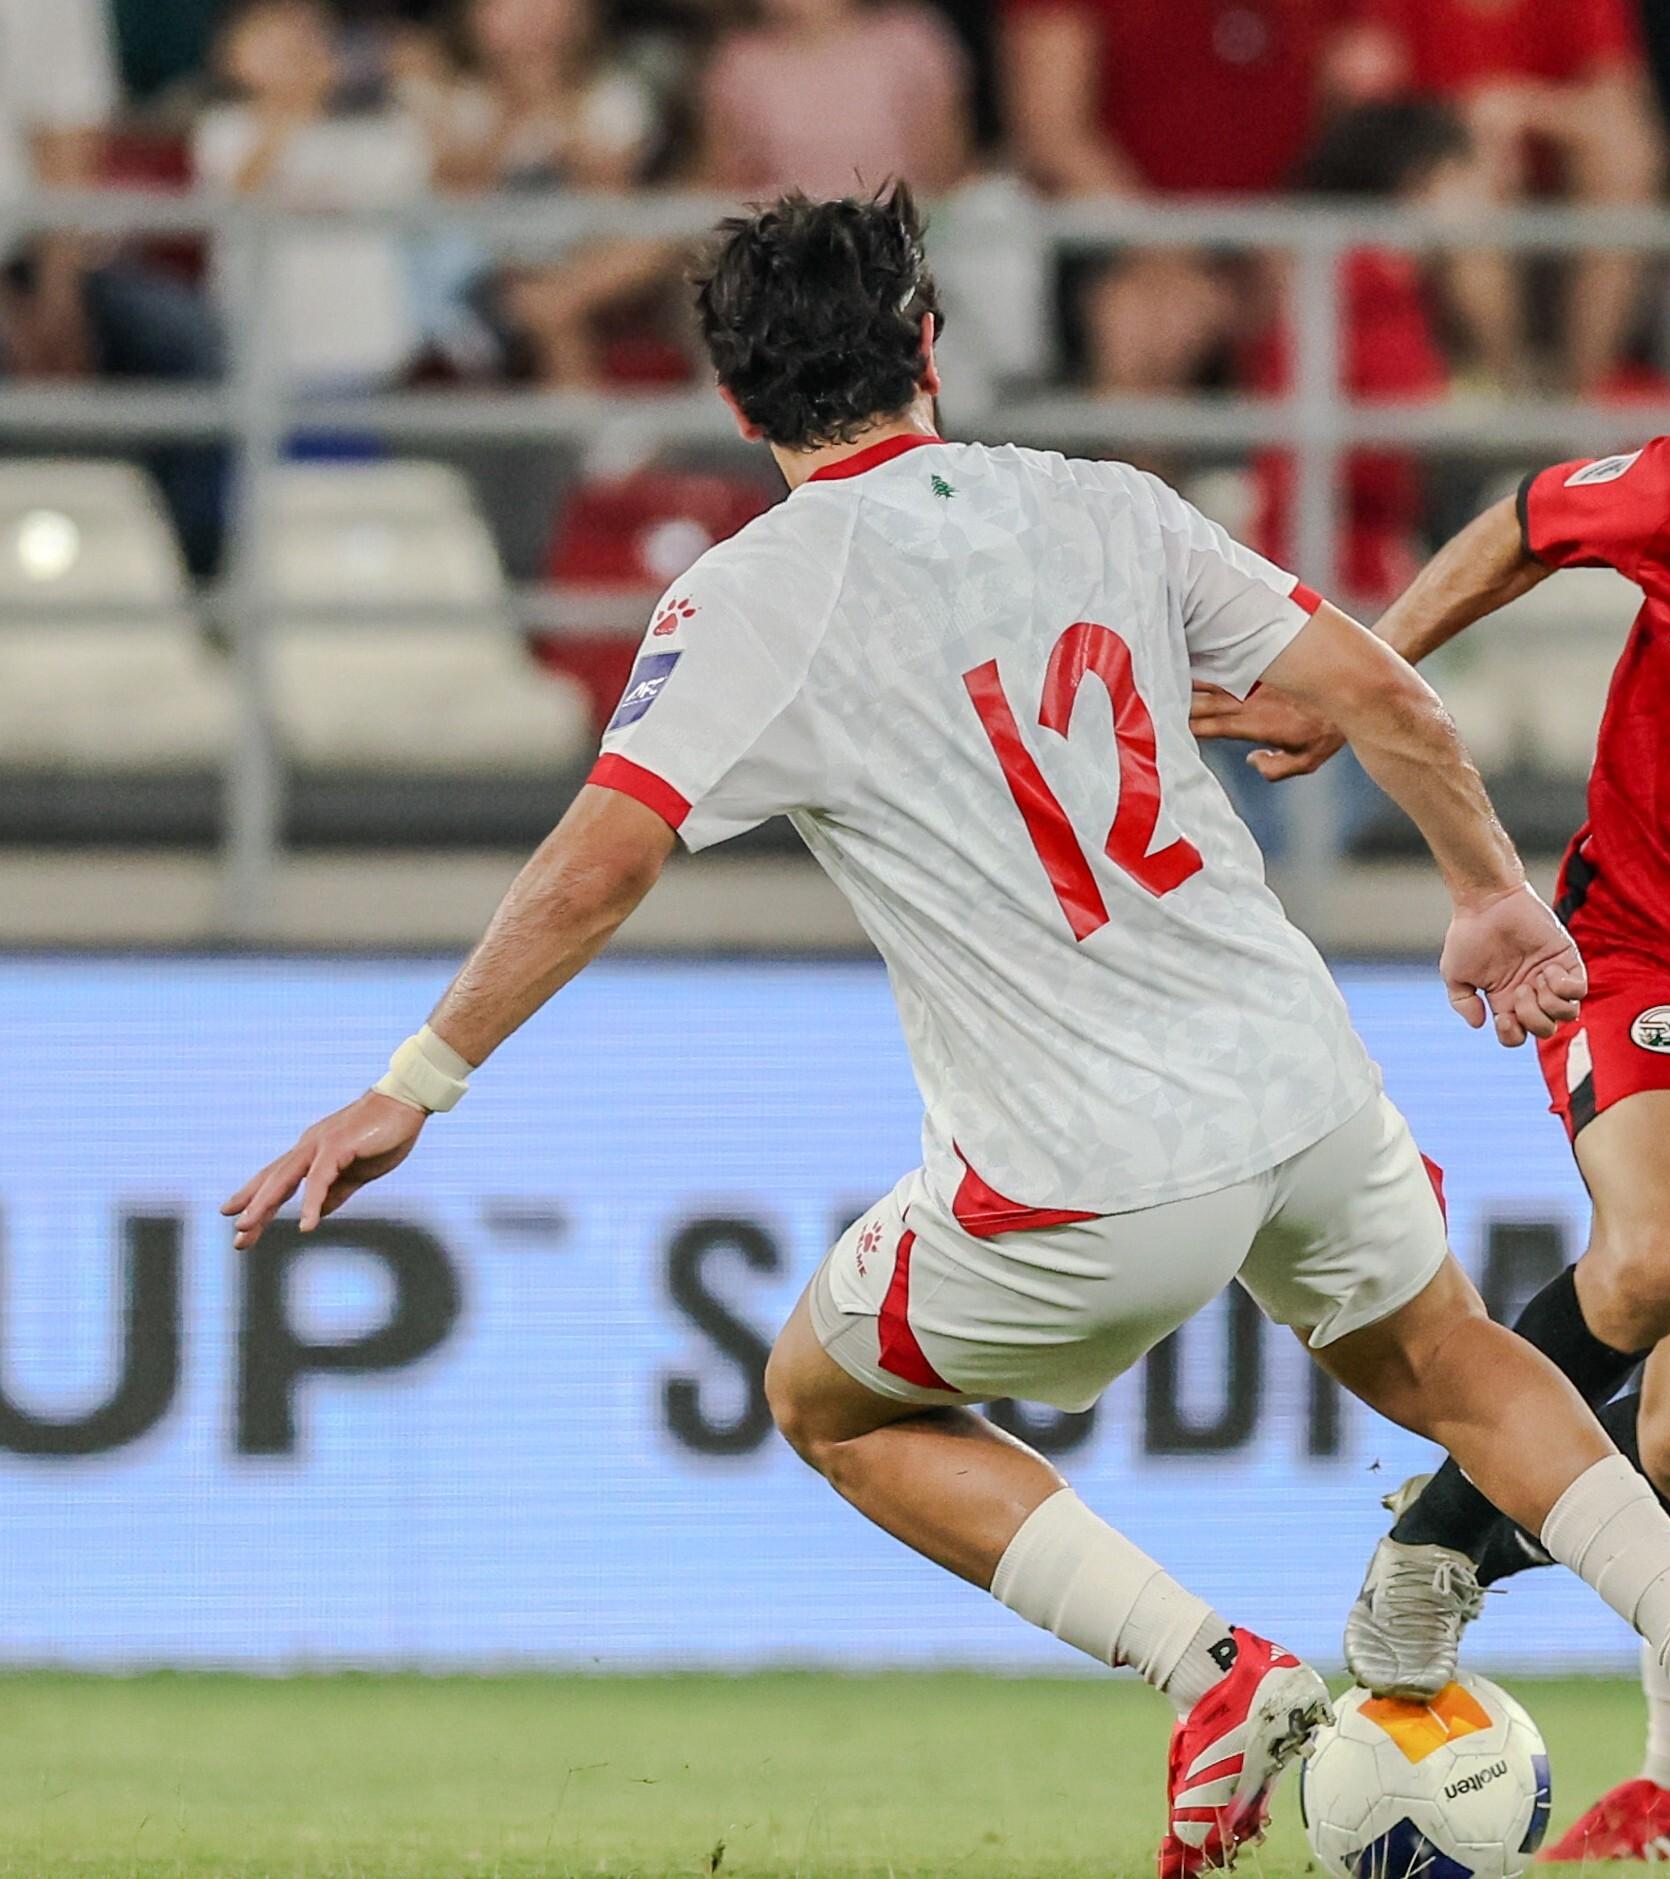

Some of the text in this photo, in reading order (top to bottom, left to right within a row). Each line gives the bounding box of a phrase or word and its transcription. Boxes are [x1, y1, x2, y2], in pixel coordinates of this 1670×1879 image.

[625, 676, 667, 702] AFC
[961, 621, 1204, 942] 12
[1444, 1760, 1508, 1798] molten
